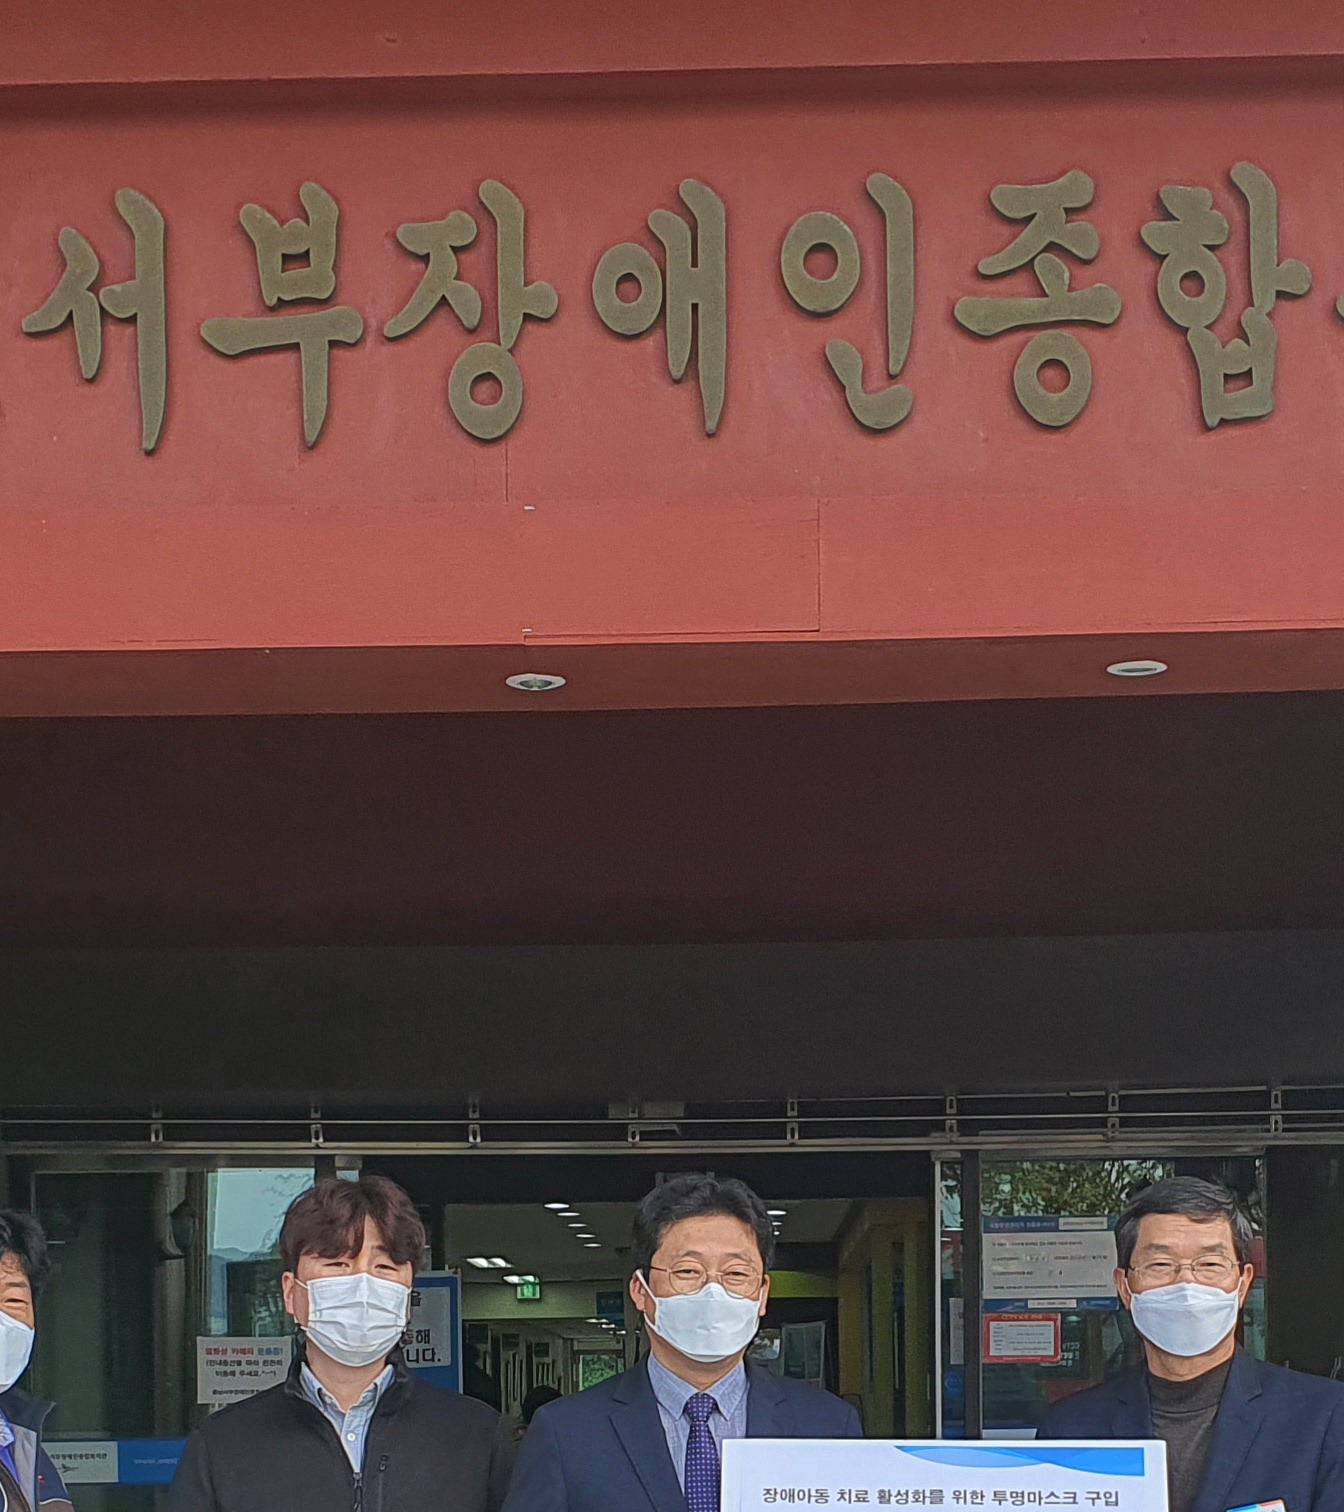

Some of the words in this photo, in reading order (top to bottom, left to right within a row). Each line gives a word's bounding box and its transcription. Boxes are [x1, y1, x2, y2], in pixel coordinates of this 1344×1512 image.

[406, 1348, 441, 1363] 니다.
[762, 1487, 830, 1504] 장애아동
[837, 1488, 871, 1504] 치료
[877, 1488, 945, 1505] 활성화를
[952, 1489, 985, 1506] 위한
[991, 1490, 1079, 1506] 투명마스크
[1084, 1490, 1119, 1507] 구입
